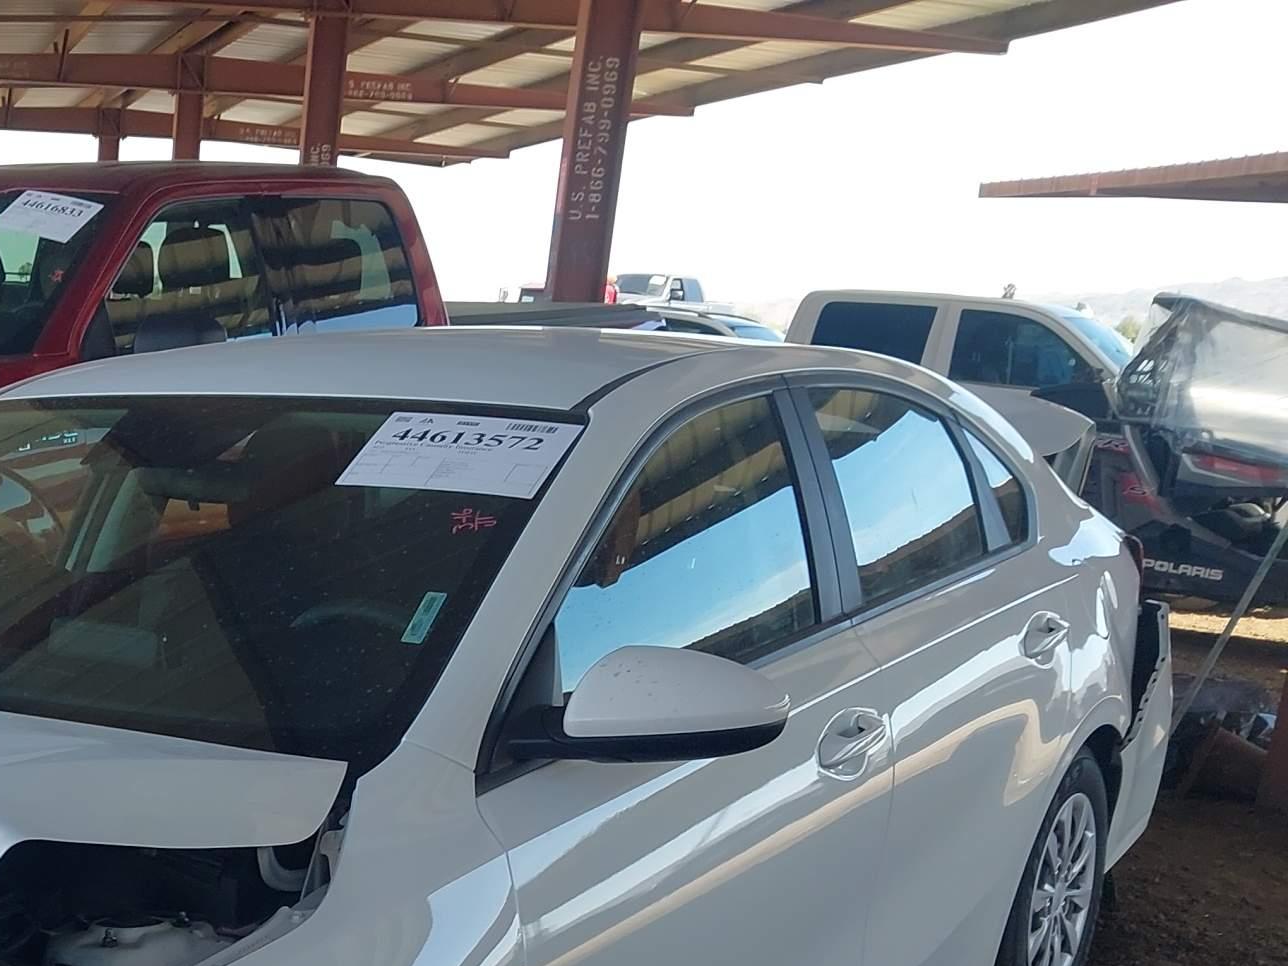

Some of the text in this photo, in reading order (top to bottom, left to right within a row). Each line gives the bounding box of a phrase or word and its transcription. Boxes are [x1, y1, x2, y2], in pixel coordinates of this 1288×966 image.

[568, 55, 603, 221] U.S. PREFAB INC.
[585, 57, 620, 220] 1-866-799-0969
[22, 199, 84, 217] 44616833
[392, 428, 544, 451] 44613572
[1142, 558, 1224, 581] POLARIS
